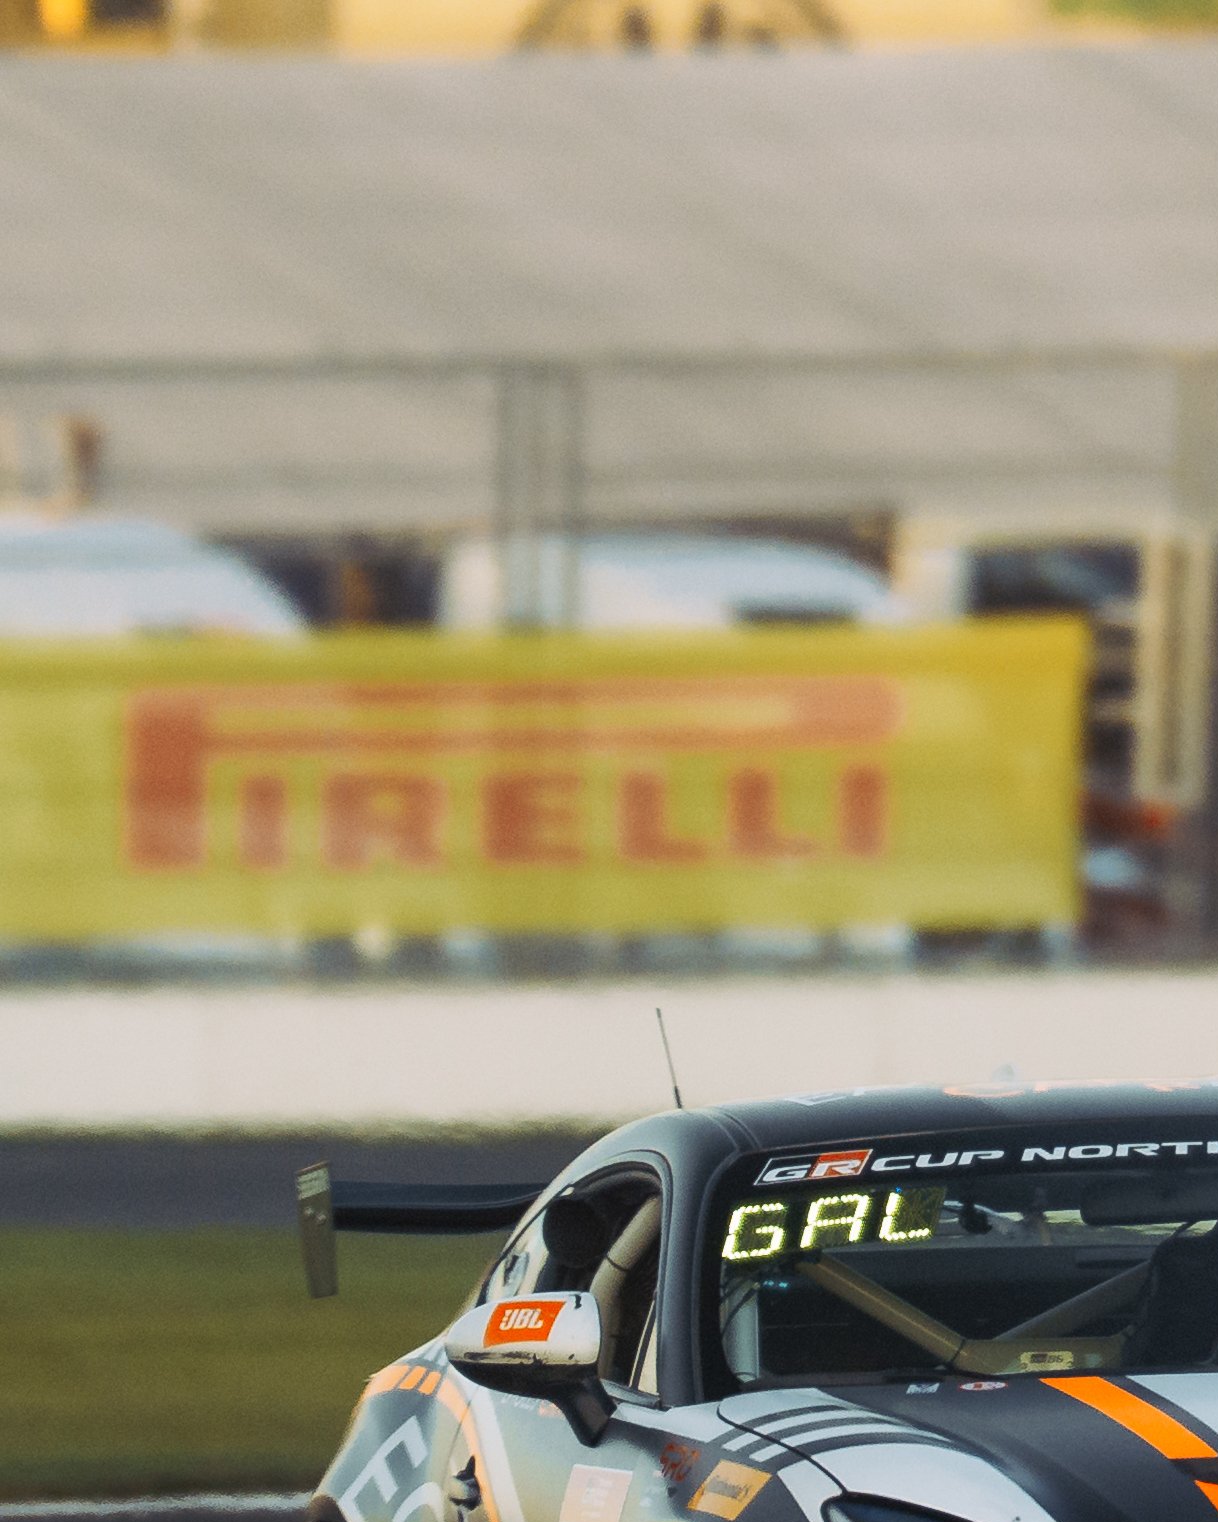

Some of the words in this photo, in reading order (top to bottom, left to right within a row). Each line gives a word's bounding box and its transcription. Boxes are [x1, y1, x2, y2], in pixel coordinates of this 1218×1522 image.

[126, 674, 903, 869] PIRELLI
[763, 1154, 862, 1184] GR
[871, 1149, 1004, 1173] CUP
[721, 1192, 931, 1261] GAL
[499, 1308, 544, 1331] JBL
